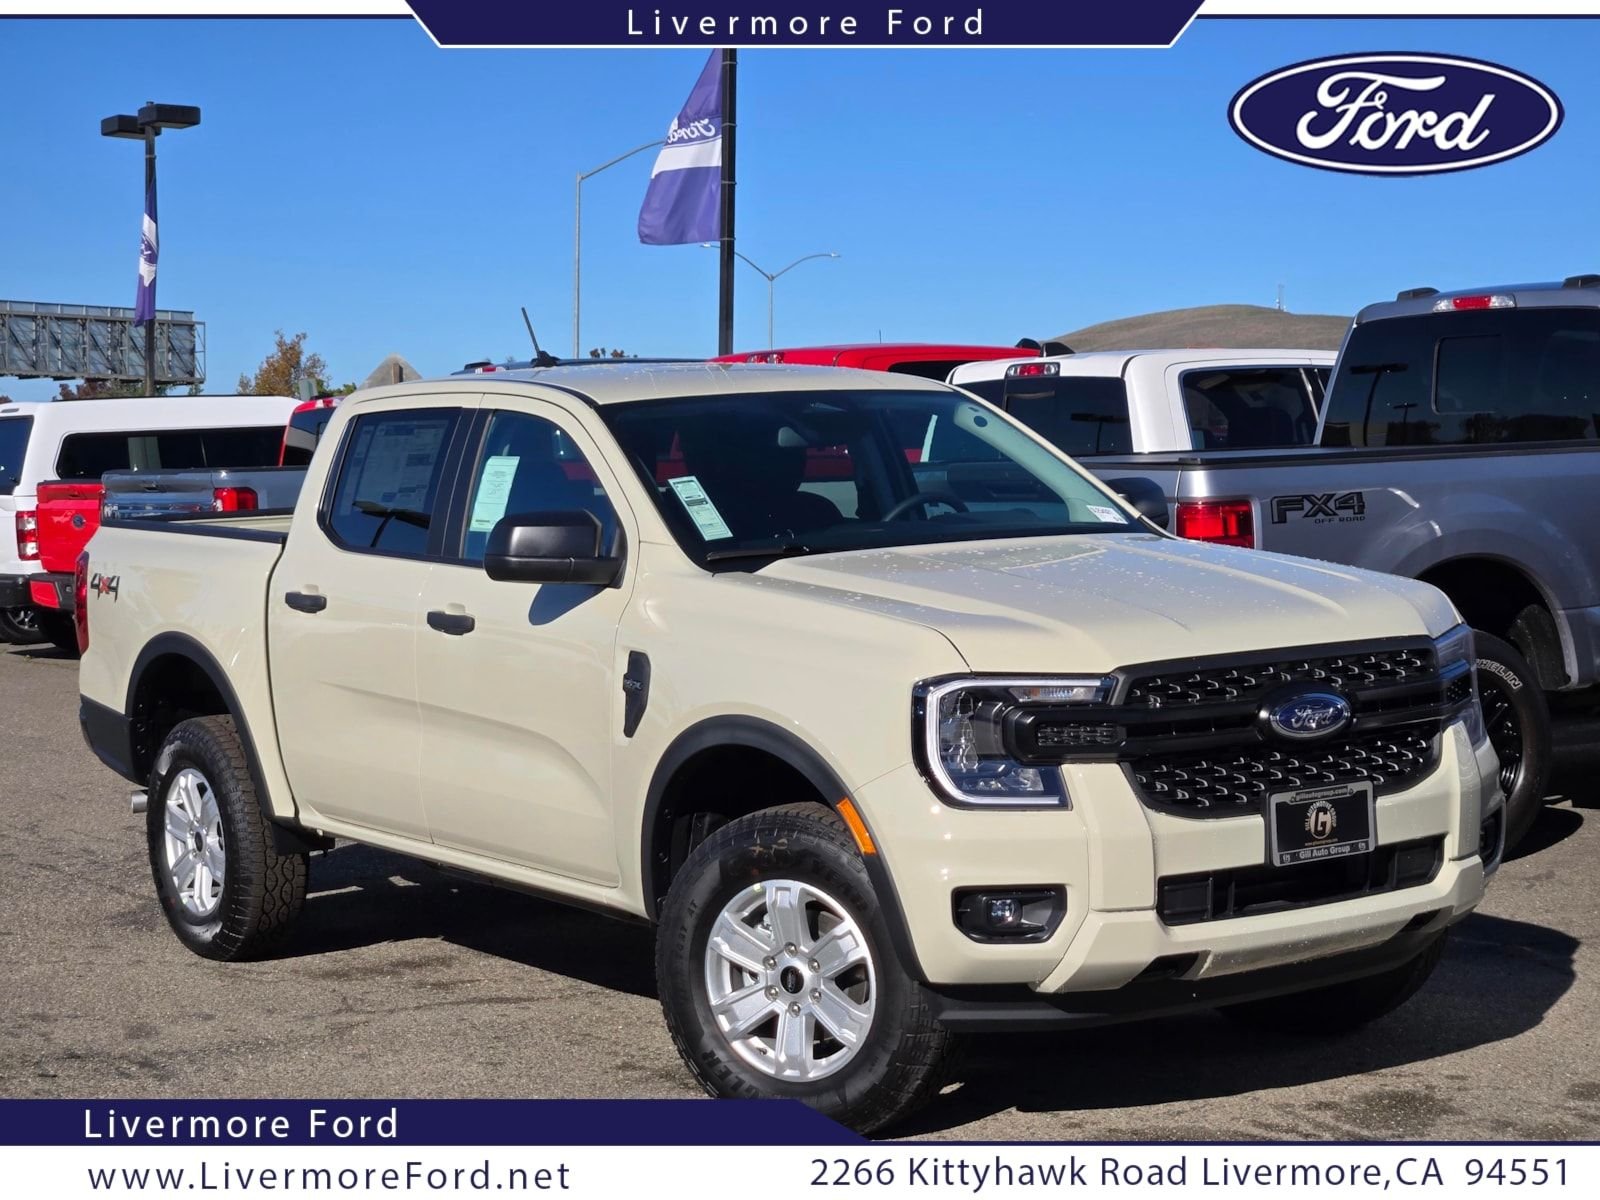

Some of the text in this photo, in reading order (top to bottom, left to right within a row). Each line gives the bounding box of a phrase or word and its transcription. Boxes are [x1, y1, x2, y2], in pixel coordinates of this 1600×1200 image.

[1270, 492, 1365, 524] FX4
[1291, 704, 1334, 729] Ford
[1299, 850, 1311, 859] Gill
[1312, 847, 1329, 857] Auto
[1329, 845, 1351, 855] Group
